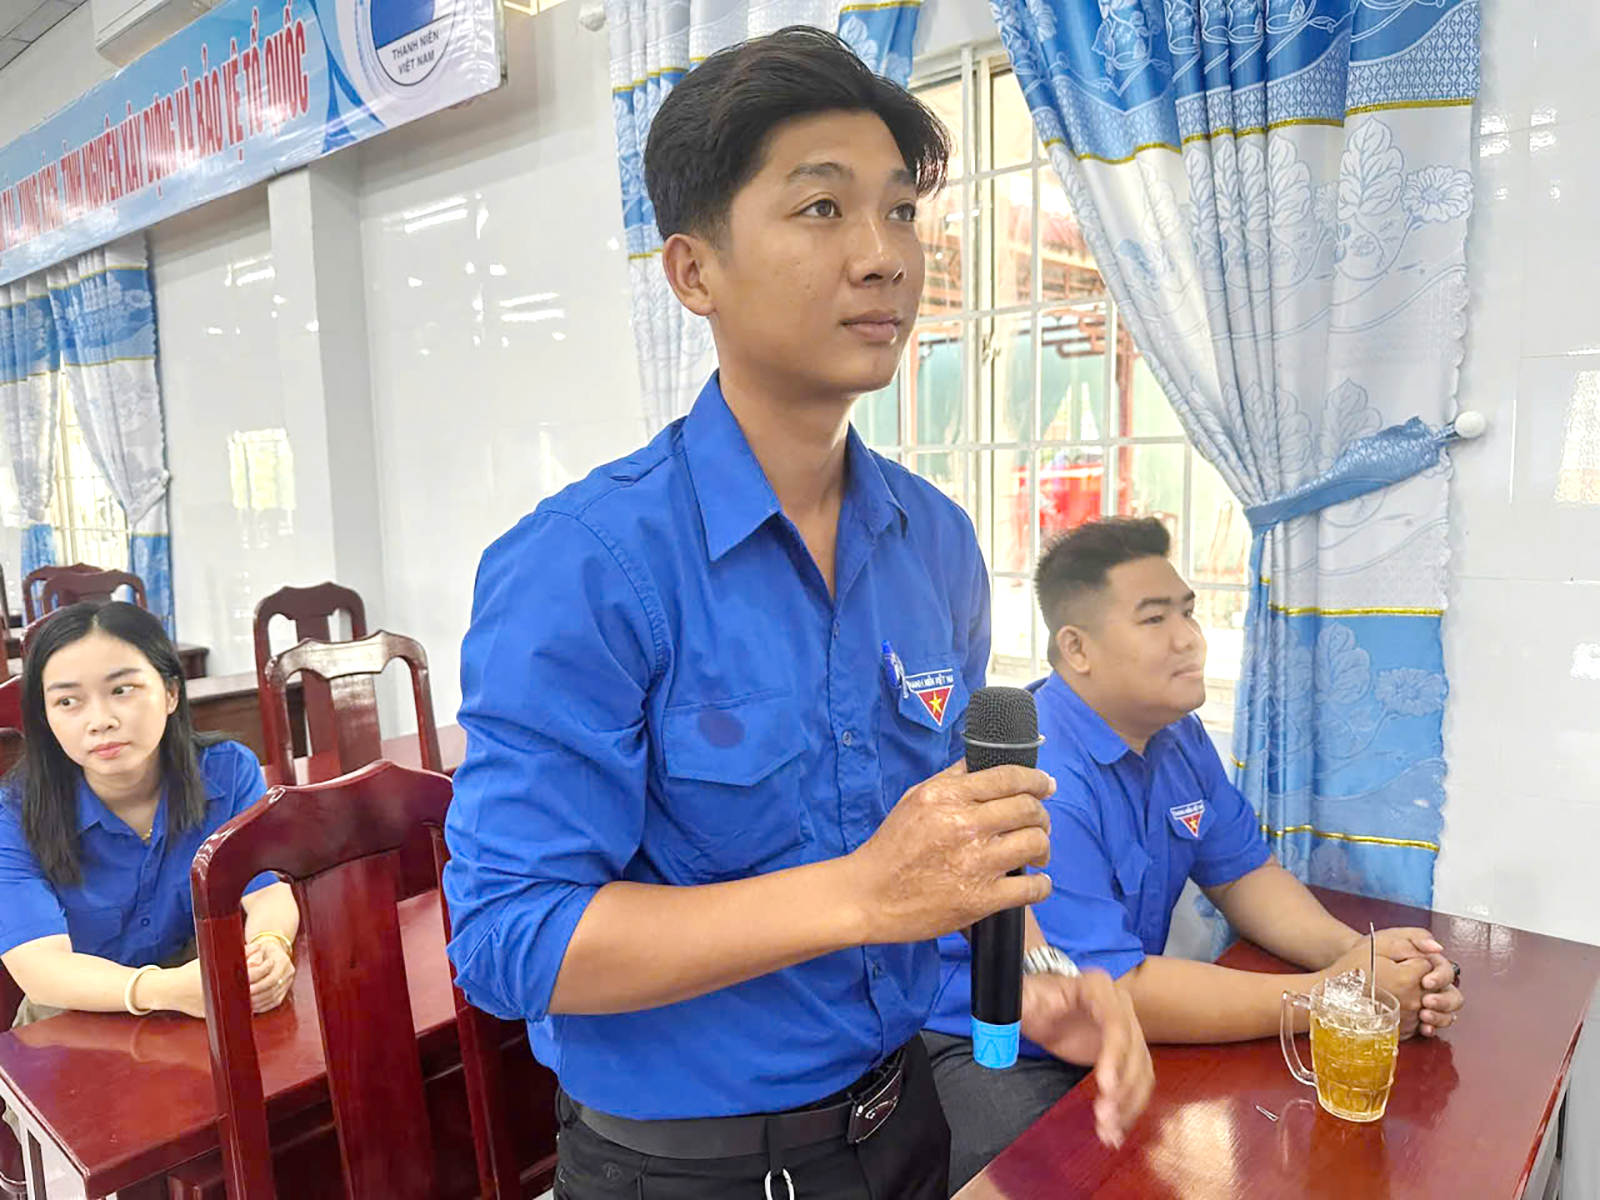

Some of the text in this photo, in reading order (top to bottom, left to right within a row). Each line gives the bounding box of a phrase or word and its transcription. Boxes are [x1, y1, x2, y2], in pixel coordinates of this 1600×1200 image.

[392, 30, 440, 60] THANH NIÊN
[398, 50, 435, 74] VIỆT NAM
[120, 101, 144, 194] XÂY
[143, 92, 177, 197] DỰNG
[175, 68, 194, 171] VÀ
[195, 44, 222, 159] BẢO
[222, 38, 244, 162] VỆ
[242, 7, 263, 137] TỔ
[265, 0, 308, 136] QUỐC
